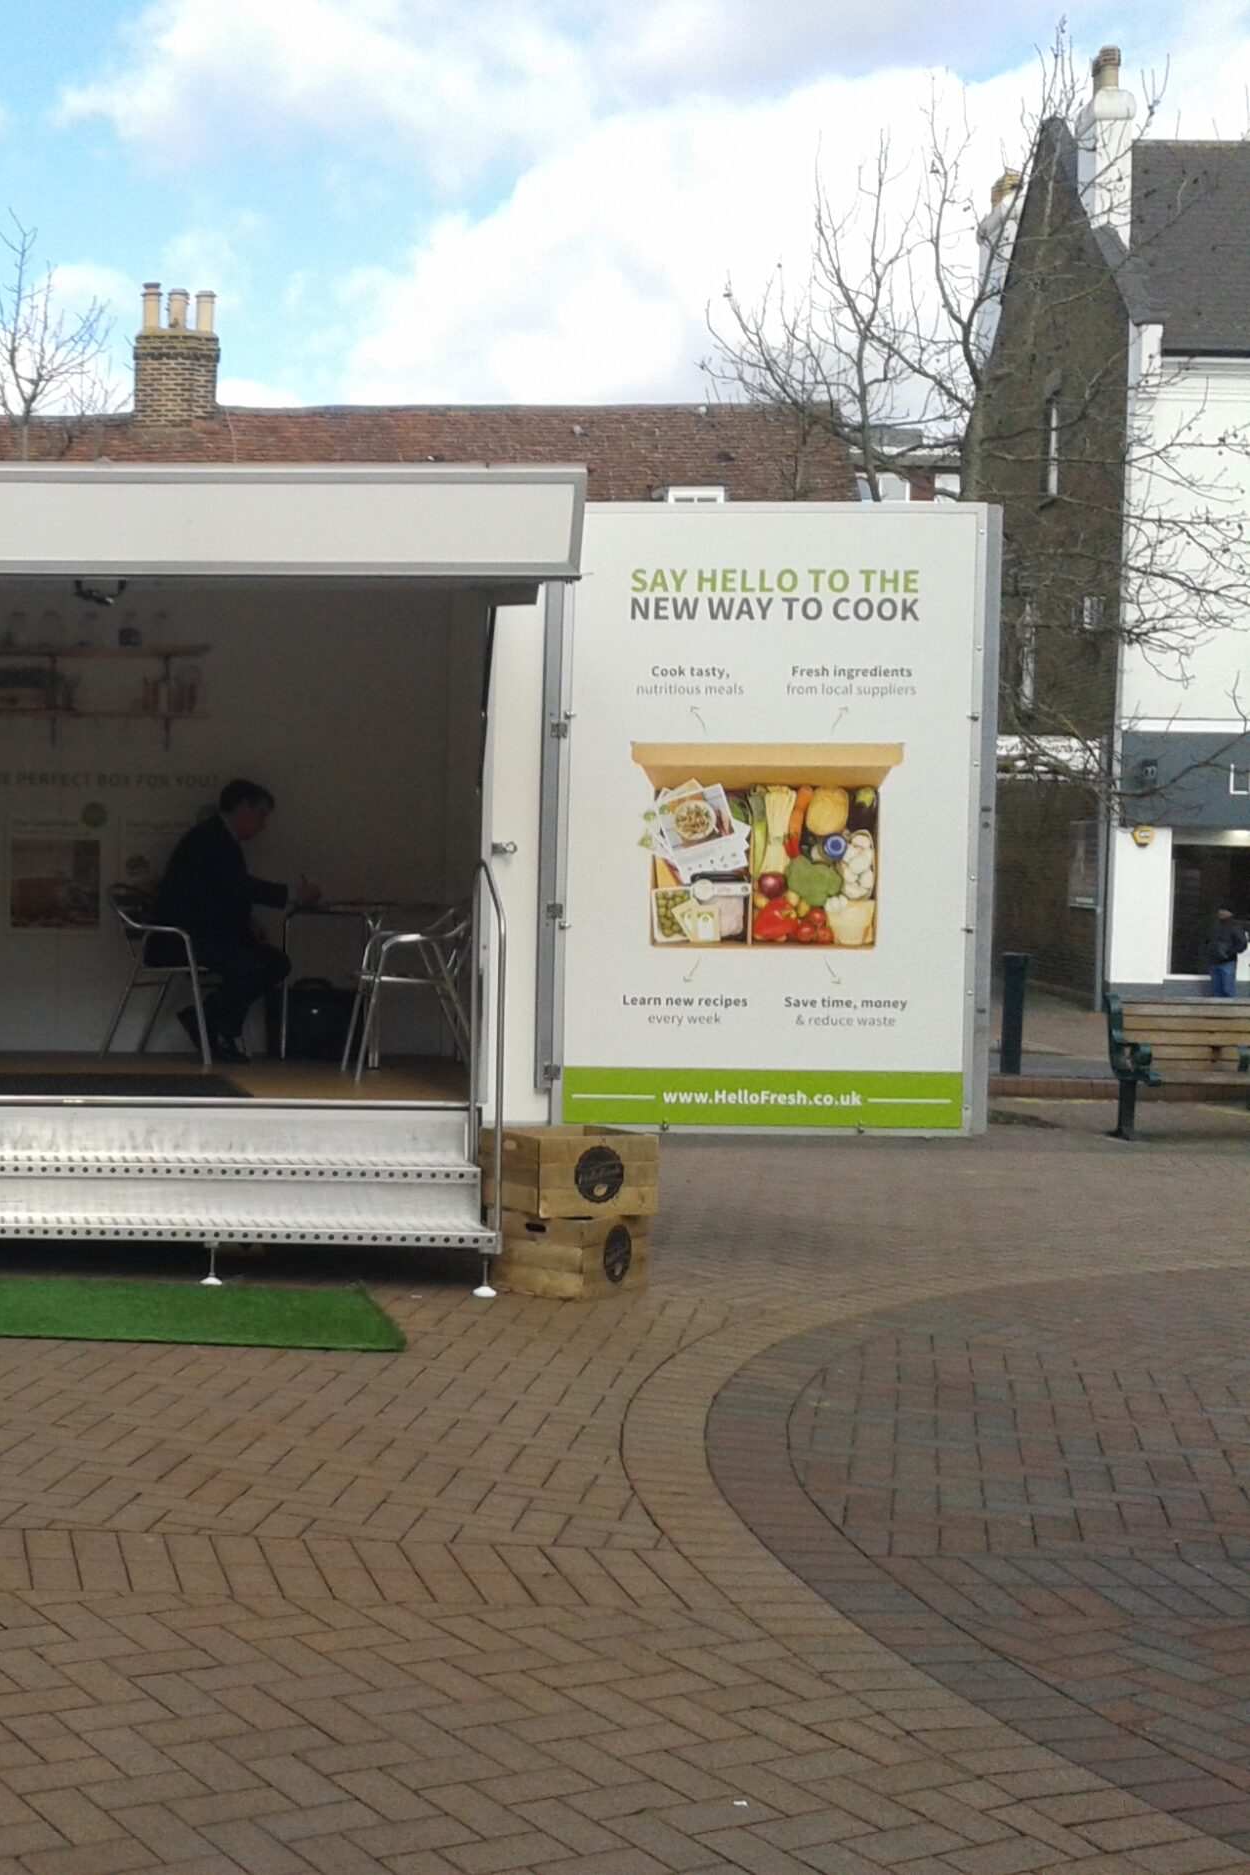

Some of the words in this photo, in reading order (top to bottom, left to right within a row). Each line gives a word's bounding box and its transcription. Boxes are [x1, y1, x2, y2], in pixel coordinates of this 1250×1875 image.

[630, 568, 688, 593] SAY
[697, 568, 799, 593] HELLO
[808, 569, 850, 593] TO
[859, 569, 920, 593] THE
[630, 597, 699, 620] NEW
[708, 598, 775, 620] WAY
[782, 598, 823, 621] TO
[832, 598, 920, 621] COOK
[651, 666, 686, 677] Cook
[689, 666, 730, 680] tasty,
[791, 666, 830, 677] Fresh
[834, 666, 912, 680] ingredients
[636, 683, 701, 695] nutritious
[705, 683, 744, 695] meals
[786, 683, 818, 695] from
[821, 683, 853, 695] local
[856, 683, 917, 698] suppliers
[623, 994, 662, 1007] Learn
[665, 997, 694, 1007] new
[698, 995, 748, 1009] recipes
[784, 997, 818, 1008] Save
[821, 997, 858, 1010] time,
[861, 999, 908, 1012] money
[648, 1014, 683, 1027] every
[686, 1012, 722, 1024] week
[795, 1015, 805, 1026] &
[808, 1015, 854, 1026] reduce
[857, 1016, 896, 1027] waste
[663, 1089, 862, 1107] www.HelloFresh.co.uk
